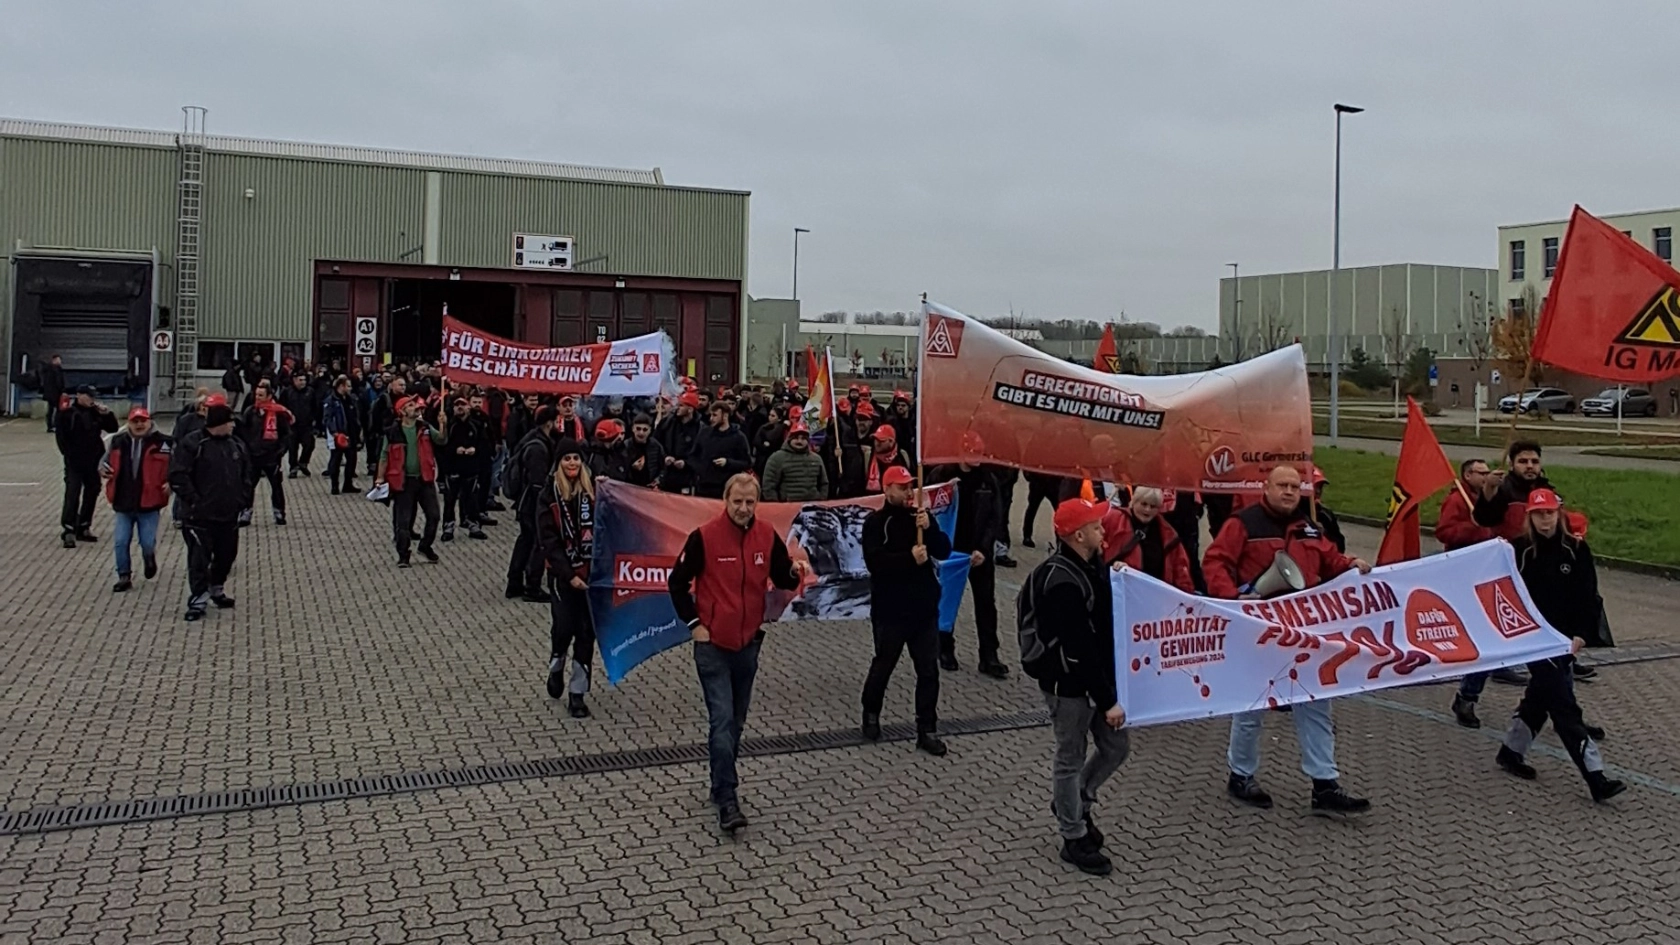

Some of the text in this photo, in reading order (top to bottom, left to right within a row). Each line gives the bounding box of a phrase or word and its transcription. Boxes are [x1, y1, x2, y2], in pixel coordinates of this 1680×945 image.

[360, 321, 373, 332] A1
[156, 335, 169, 347] A4
[359, 340, 373, 351] A2
[449, 331, 484, 354] FÜR
[488, 341, 592, 362] EINKOMMEN
[448, 351, 592, 383] BESCHÄFTIGUNG
[1604, 345, 1638, 370] IG
[1024, 373, 1141, 407] GERECHTIGKEIT
[997, 386, 1160, 427] GIBT ES NUR MIT UNS!
[1417, 607, 1449, 625] DAFÜR
[1133, 615, 1232, 642] SOLIDARITÄT
[1416, 625, 1459, 641] STREITEN
[1161, 634, 1226, 658] GEWINNT
